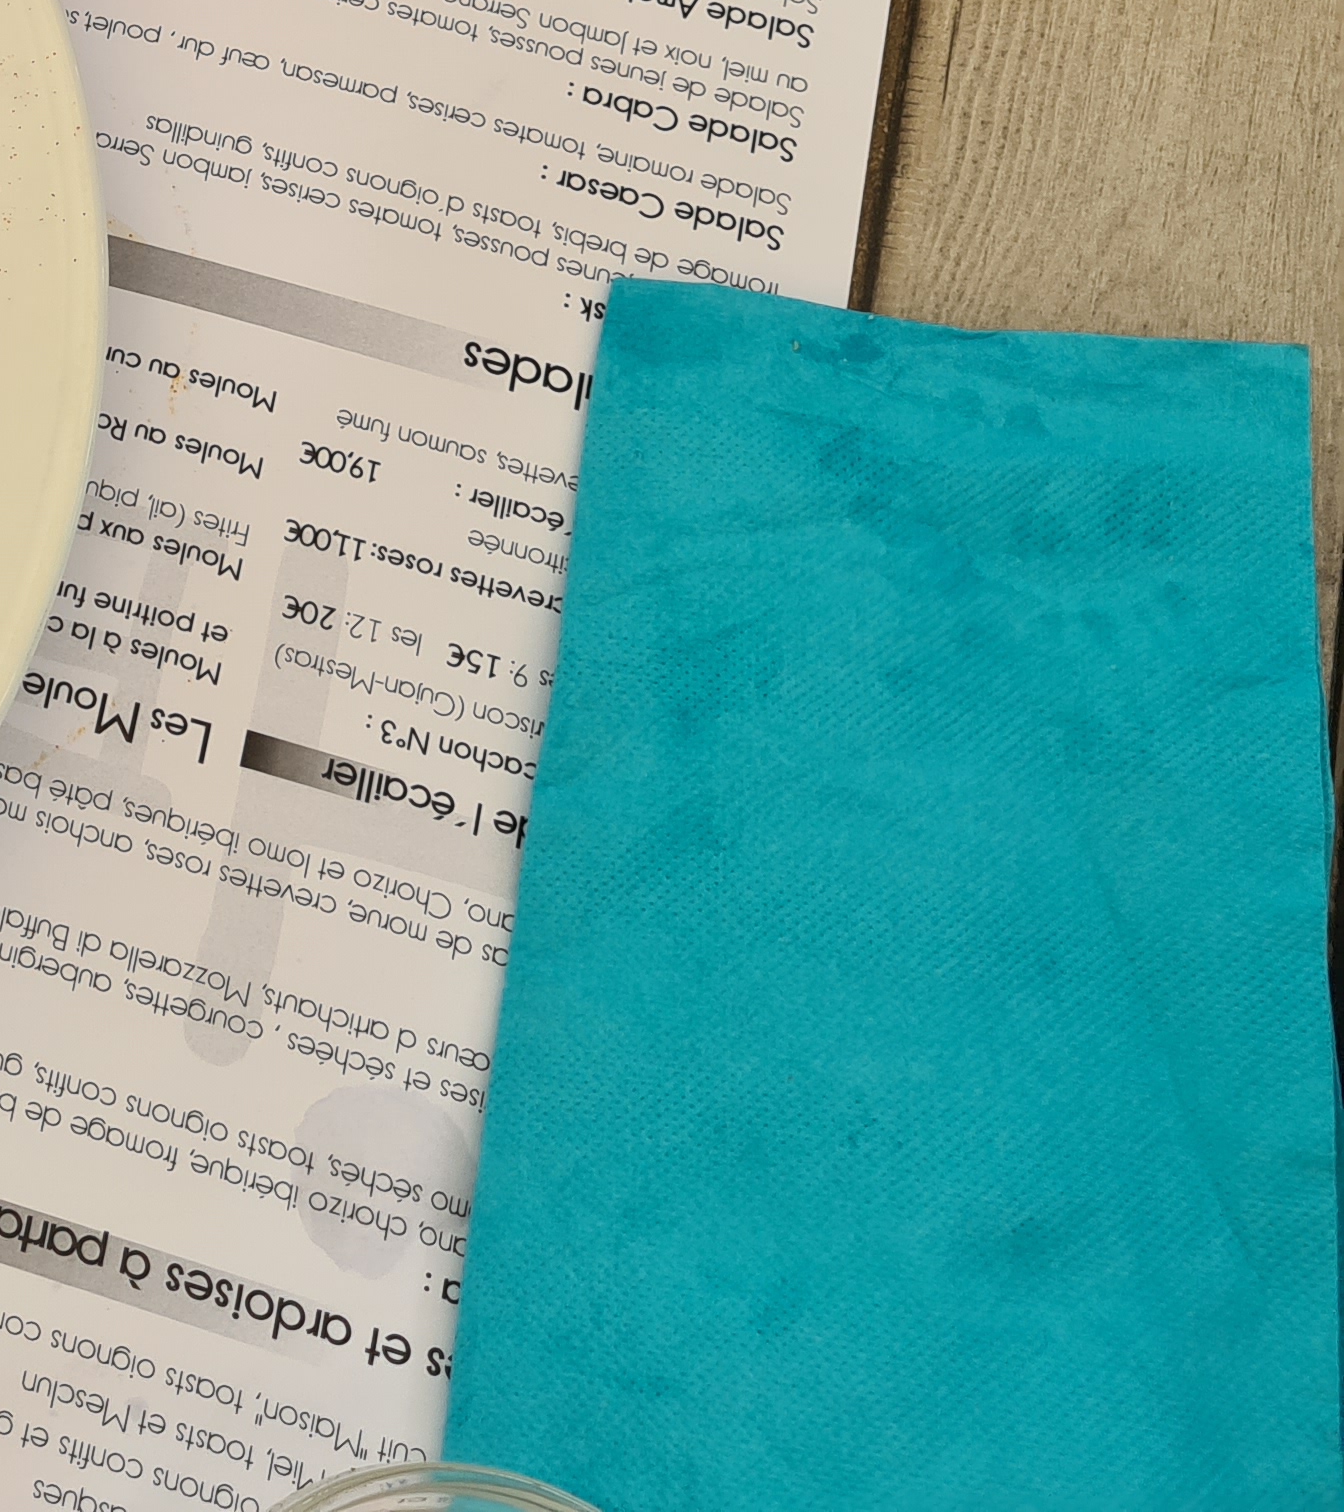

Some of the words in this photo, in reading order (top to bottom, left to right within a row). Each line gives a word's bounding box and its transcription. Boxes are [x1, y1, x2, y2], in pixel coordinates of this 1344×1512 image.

[84, 11, 162, 43] poulet,
[539, 13, 629, 55] Jambon
[706, 1, 814, 48] Salade
[177, 36, 215, 60] dur
[219, 47, 270, 70] œuf
[664, 45, 712, 69] noix
[722, 56, 769, 83] miel,
[281, 58, 398, 103] parmesan,
[591, 56, 667, 91] jeunes
[582, 86, 679, 132] Cabra
[714, 87, 804, 128] Salade
[146, 115, 253, 155] guindillas
[494, 118, 585, 160] tomates
[688, 114, 797, 163] Salade
[162, 149, 253, 189] jambon
[262, 142, 338, 177] confits,
[596, 143, 694, 183] romaine,
[261, 172, 341, 209] cerises,
[556, 170, 664, 219] Caesar
[700, 173, 792, 216] Salade
[349, 199, 441, 242] tomates
[674, 201, 784, 251] Salade
[552, 221, 627, 265] brebis,
[184, 369, 277, 413] Moules
[464, 341, 593, 411] lades
[336, 409, 391, 442] fumé
[398, 426, 487, 464] saumon
[174, 435, 263, 480] Moules
[299, 441, 381, 483] 19,00€
[148, 494, 185, 528] (ail,
[193, 510, 250, 547] Frites
[153, 535, 243, 581] Moules
[284, 519, 367, 561] 11,00€
[371, 543, 443, 577] roses:
[94, 592, 196, 633] poitrine
[282, 595, 336, 630] 20€
[345, 612, 382, 642] 12:
[130, 639, 222, 686] Moules
[446, 643, 501, 678] 15€
[22, 672, 141, 744] Moule
[150, 708, 212, 763] Les
[49, 779, 113, 811] pâté
[35, 810, 133, 853] anchois
[123, 797, 240, 856] ibériques,
[144, 839, 212, 876] roses,
[248, 838, 311, 878] lomo
[219, 865, 337, 914] crevettes
[353, 869, 452, 920] Chorizo
[348, 899, 428, 942] morue,
[109, 940, 251, 1007] Mozzarella
[124, 978, 264, 1039] courgettes,
[262, 983, 389, 1040] artichauts,
[287, 1032, 396, 1080] séchées
[34, 1062, 117, 1106] confits,
[126, 1095, 229, 1142] oignons
[70, 1116, 178, 1172] fromage
[190, 1149, 299, 1211] ibérique,
[328, 1154, 423, 1203] séchés,
[308, 1192, 407, 1241] chorizo
[119, 1247, 151, 1290] à
[165, 1263, 352, 1346] ardoises
[365, 1327, 411, 1366] et
[22, 1370, 131, 1433] Mesclun
[59, 1435, 143, 1479] confits
[176, 1422, 253, 1471] toasts
[153, 1467, 260, 1512] oignons
